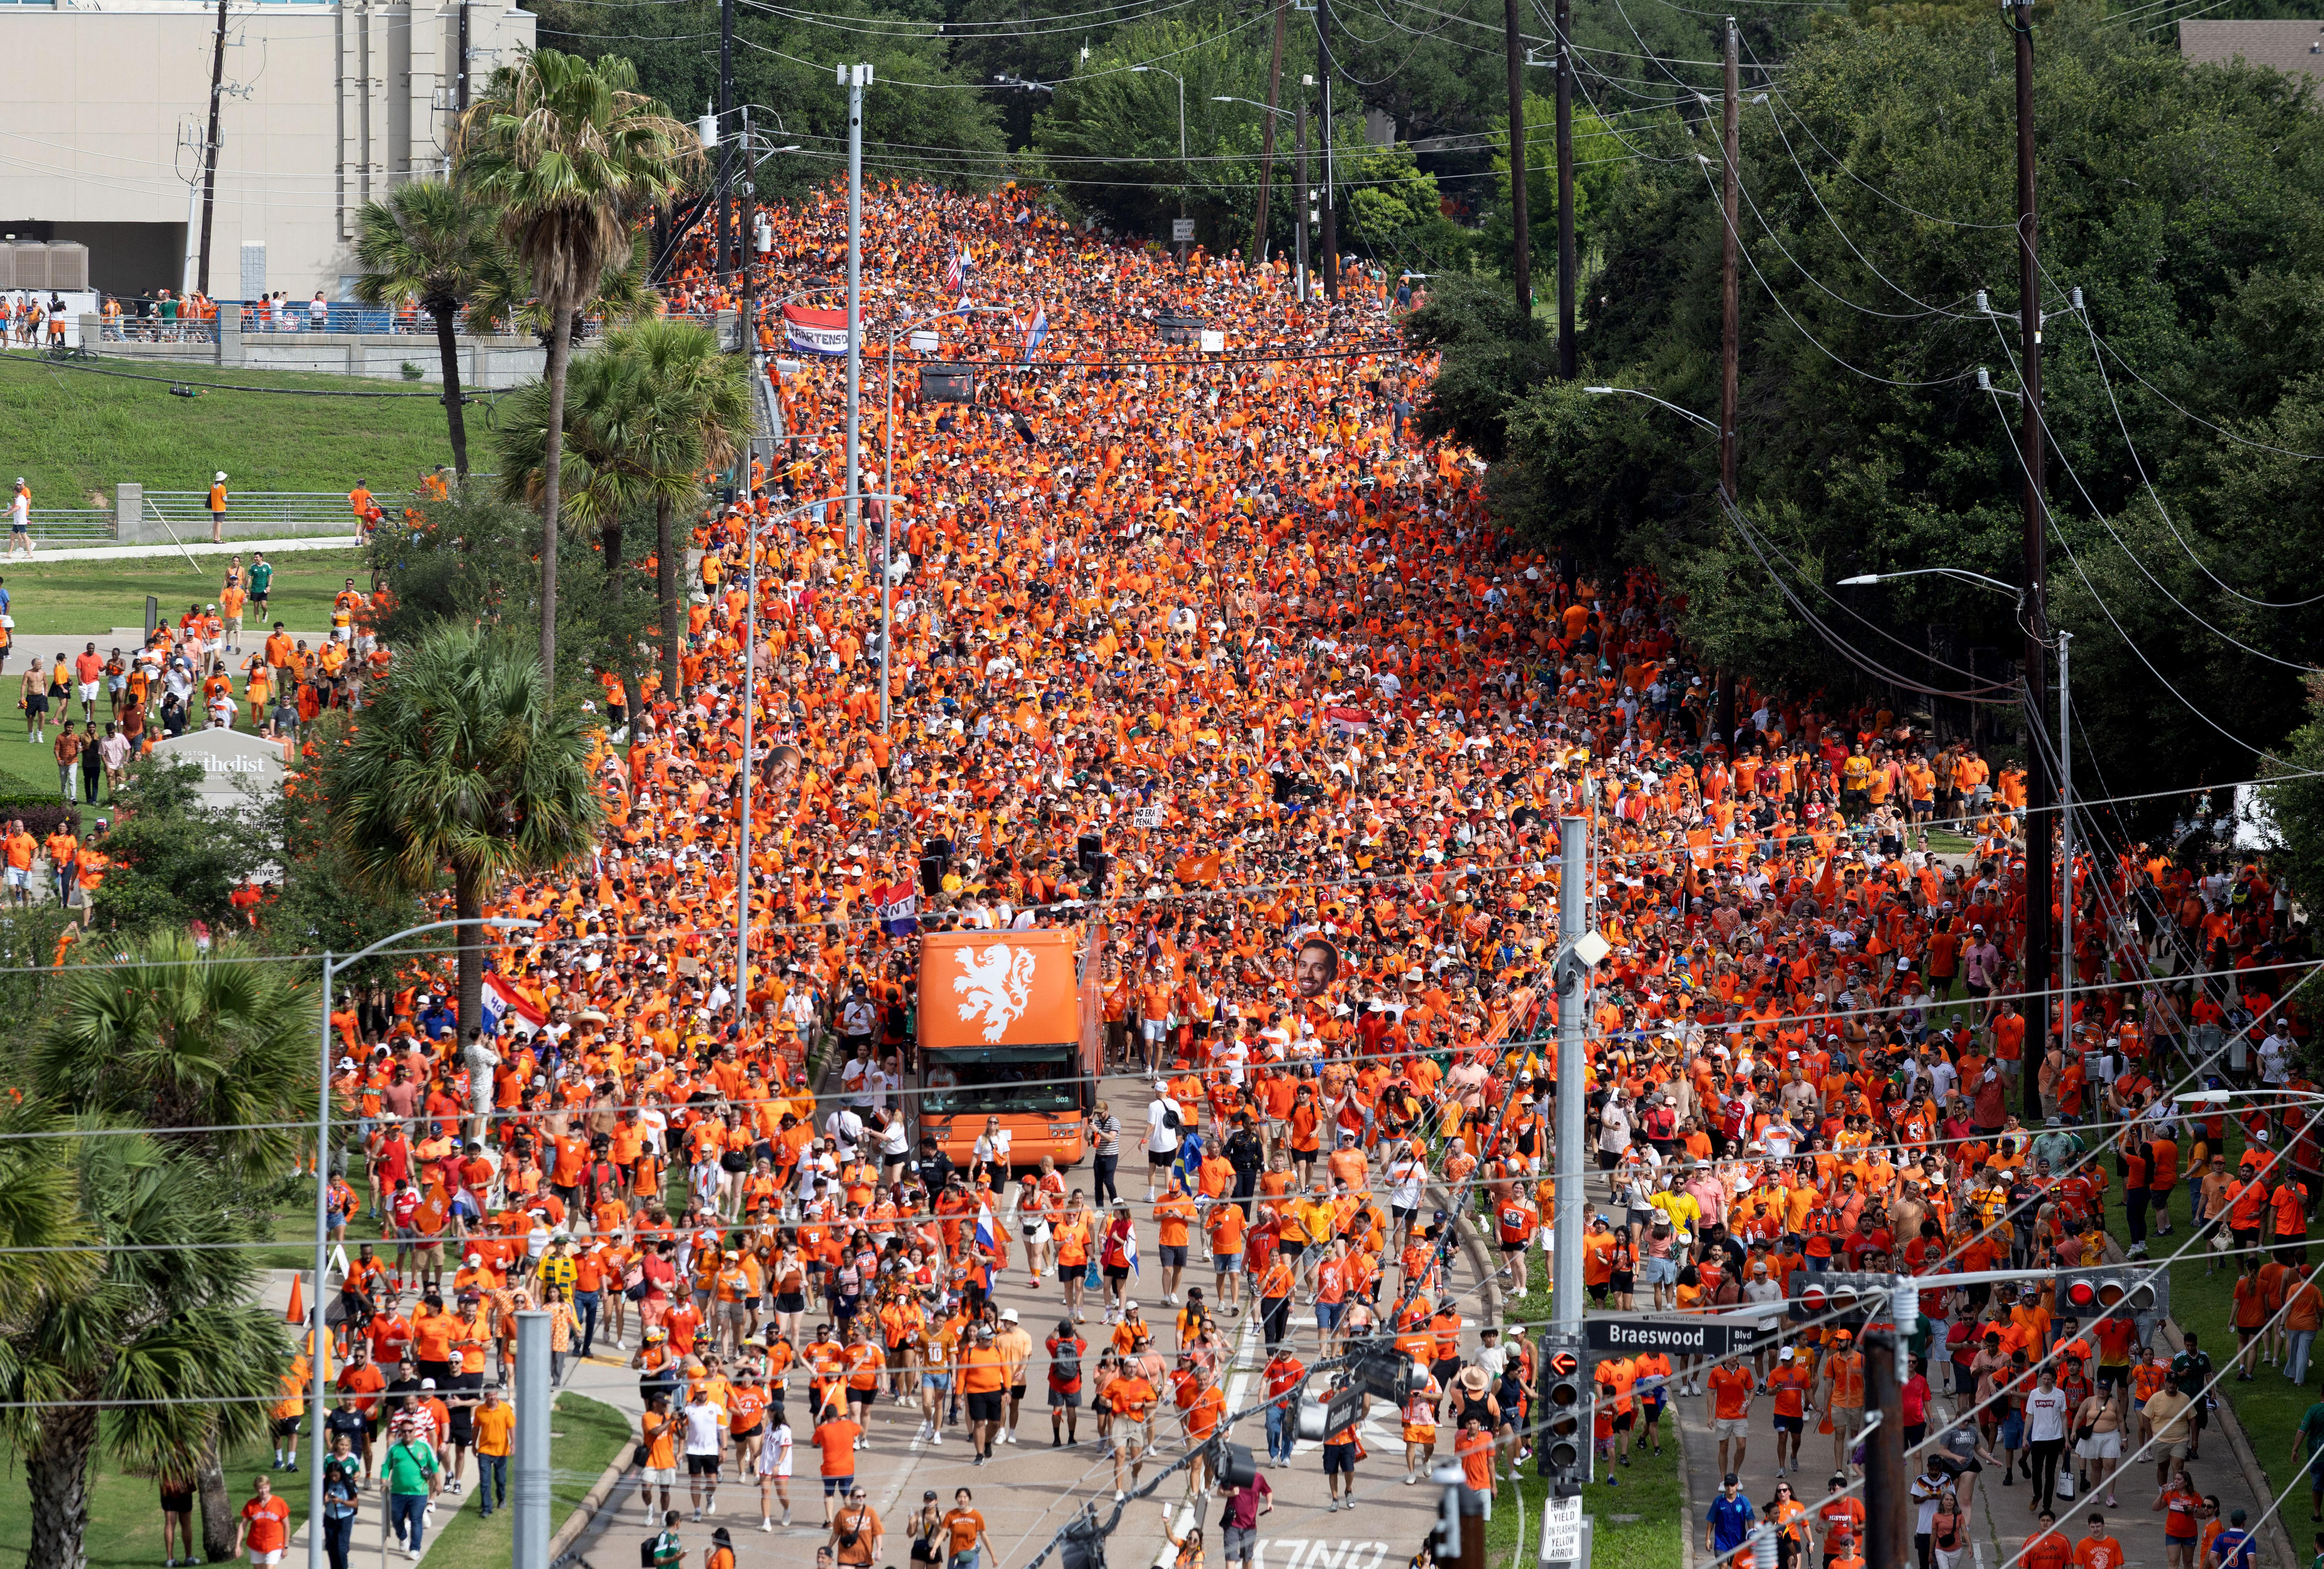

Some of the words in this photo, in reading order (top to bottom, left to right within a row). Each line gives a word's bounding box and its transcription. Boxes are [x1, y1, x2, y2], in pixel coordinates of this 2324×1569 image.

[1610, 1324, 1703, 1345] Braeswood
[1735, 1331, 1751, 1339] Blvd
[928, 1347, 942, 1362] 10
[1733, 1344, 1752, 1352] 1800
[1330, 1403, 1352, 1430] Greenbriar
[1551, 1500, 1562, 1511] LEFT
[1563, 1498, 1578, 1510] TURN
[1553, 1511, 1575, 1523] YIELD
[1548, 1527, 1555, 1536] ON
[1557, 1523, 1578, 1535] FLASHING
[1552, 1537, 1574, 1547] YELLOW
[1551, 1547, 1574, 1557] ARROW
[2228, 1546, 2238, 1567] 8
